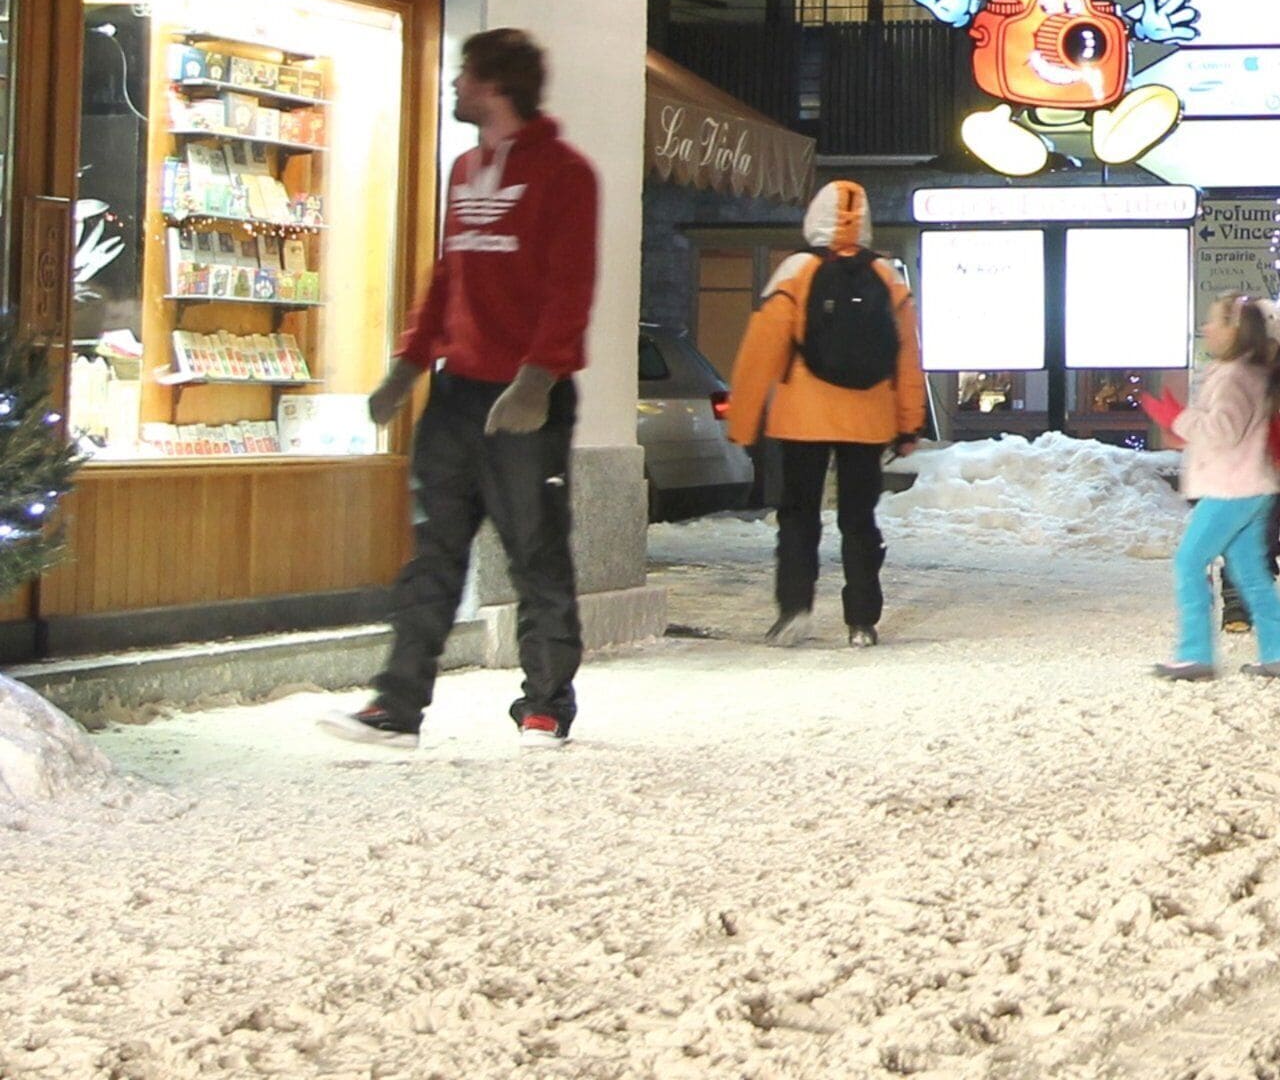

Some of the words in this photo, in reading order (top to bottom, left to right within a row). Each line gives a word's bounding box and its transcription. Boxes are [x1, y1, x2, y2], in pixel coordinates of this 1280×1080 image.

[655, 104, 693, 162] La
[699, 116, 753, 176] Viola
[1200, 250, 1212, 262] la
[1216, 251, 1257, 264] prairie
